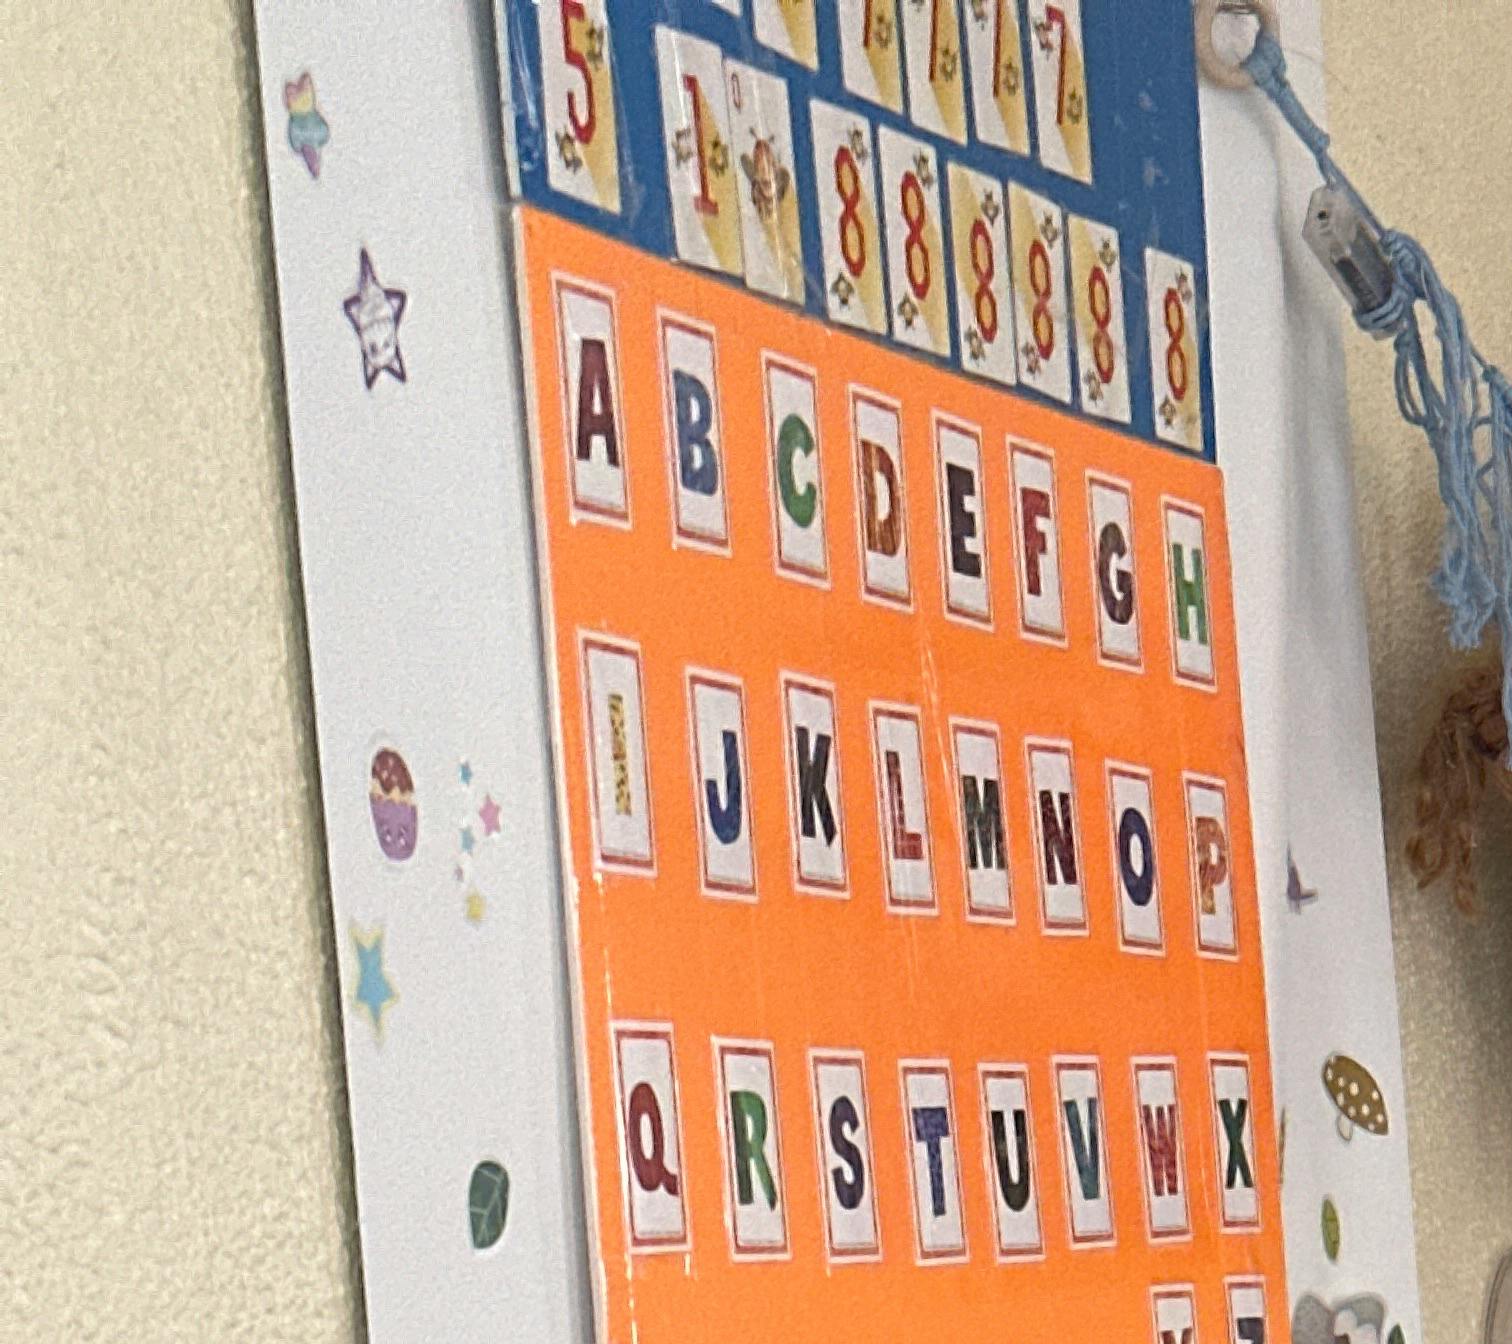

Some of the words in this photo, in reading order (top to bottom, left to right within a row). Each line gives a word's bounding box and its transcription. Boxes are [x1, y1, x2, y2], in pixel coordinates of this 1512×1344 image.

[1046, 4, 1065, 126] 7
[561, 0, 596, 144] 5
[835, 146, 866, 278] 8
[901, 172, 931, 299] 8
[969, 218, 997, 344] 8
[1028, 239, 1053, 360] 8
[1088, 267, 1114, 384] 8
[1164, 287, 1188, 400] 8
[576, 339, 619, 468] A
[675, 370, 718, 496] B
[776, 412, 816, 528] C
[861, 439, 901, 556] D
[947, 462, 981, 578] E
[1021, 489, 1050, 596] F
[1099, 522, 1134, 625] G
[1173, 542, 1208, 645] H
[608, 694, 632, 816] I
[705, 730, 743, 845] J
[797, 725, 836, 848] K
[886, 750, 922, 860] L
[960, 775, 1006, 871] M
[1039, 790, 1076, 885] N
[1118, 807, 1154, 907] O
[1195, 815, 1227, 915] P
[627, 1082, 678, 1197] Q
[728, 1090, 778, 1211] R
[829, 1095, 865, 1211] S
[912, 1107, 950, 1217] T
[991, 1109, 1030, 1213] U
[1063, 1097, 1100, 1200] V
[1141, 1104, 1178, 1197] W
[1218, 1098, 1254, 1189] X
